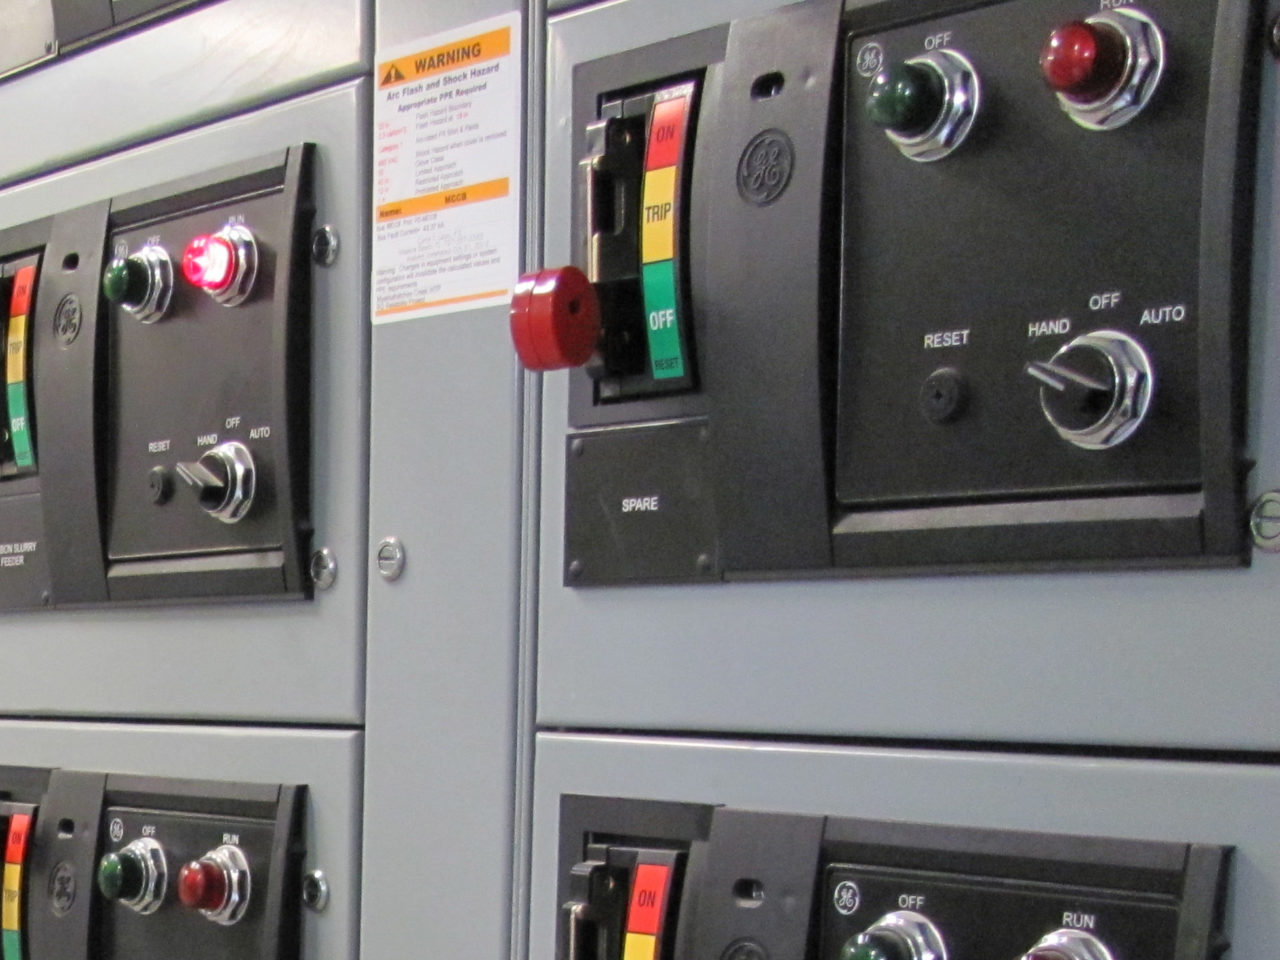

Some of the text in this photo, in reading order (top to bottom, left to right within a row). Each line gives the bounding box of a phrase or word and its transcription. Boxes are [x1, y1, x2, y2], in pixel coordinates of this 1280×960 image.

[924, 31, 953, 50] OFF
[415, 42, 482, 74] WARNING
[387, 62, 500, 101] Arc Flash and Shock Hazard
[398, 82, 487, 112] Appropriate PPE Required
[656, 123, 675, 142] ON
[645, 203, 671, 224] TRIP
[649, 309, 674, 330] OFF
[924, 291, 1185, 349] RESET HAND OFF AUTO
[655, 357, 679, 371] RESET
[11, 417, 25, 432] OFF
[148, 417, 271, 453] RESET HAND OFF AUTO
[622, 496, 659, 513] SPARE
[0, 555, 24, 567] FEEDER
[142, 825, 239, 845] OFF RUN
[638, 889, 656, 908] ON
[898, 894, 1095, 929] OFF RUN
